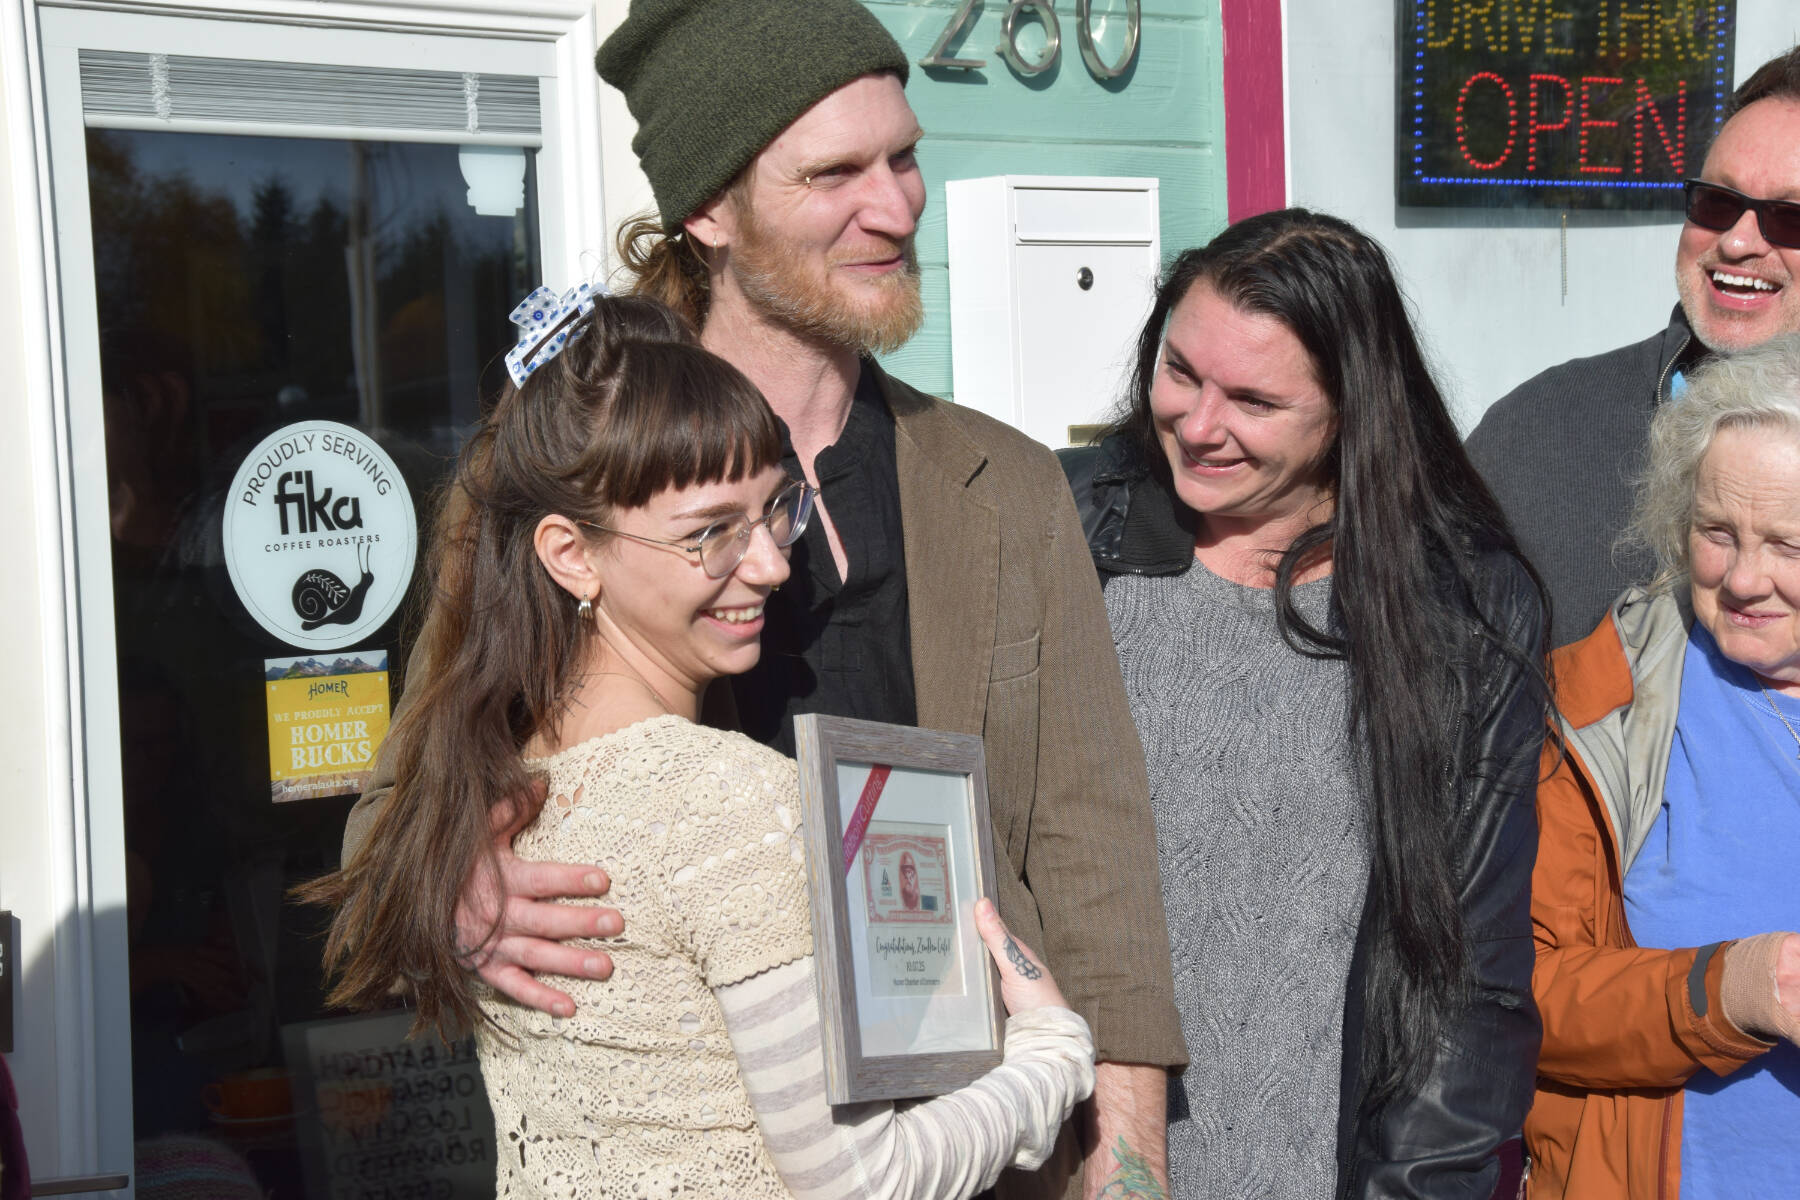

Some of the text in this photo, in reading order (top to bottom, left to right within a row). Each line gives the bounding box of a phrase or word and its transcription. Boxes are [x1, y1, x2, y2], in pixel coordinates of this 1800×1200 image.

[1455, 71, 1688, 174] OPEN
[243, 434, 392, 506] PROUDLY SERVING
[274, 470, 363, 535] fika
[265, 534, 380, 552] COFFEE ROASTERS
[308, 680, 350, 700] HOMER
[274, 704, 384, 722] WE PROUDLY ACCEPT
[290, 720, 369, 745] HOMER
[290, 740, 373, 770] BUCKS
[282, 778, 359, 794] homeralaska.org
